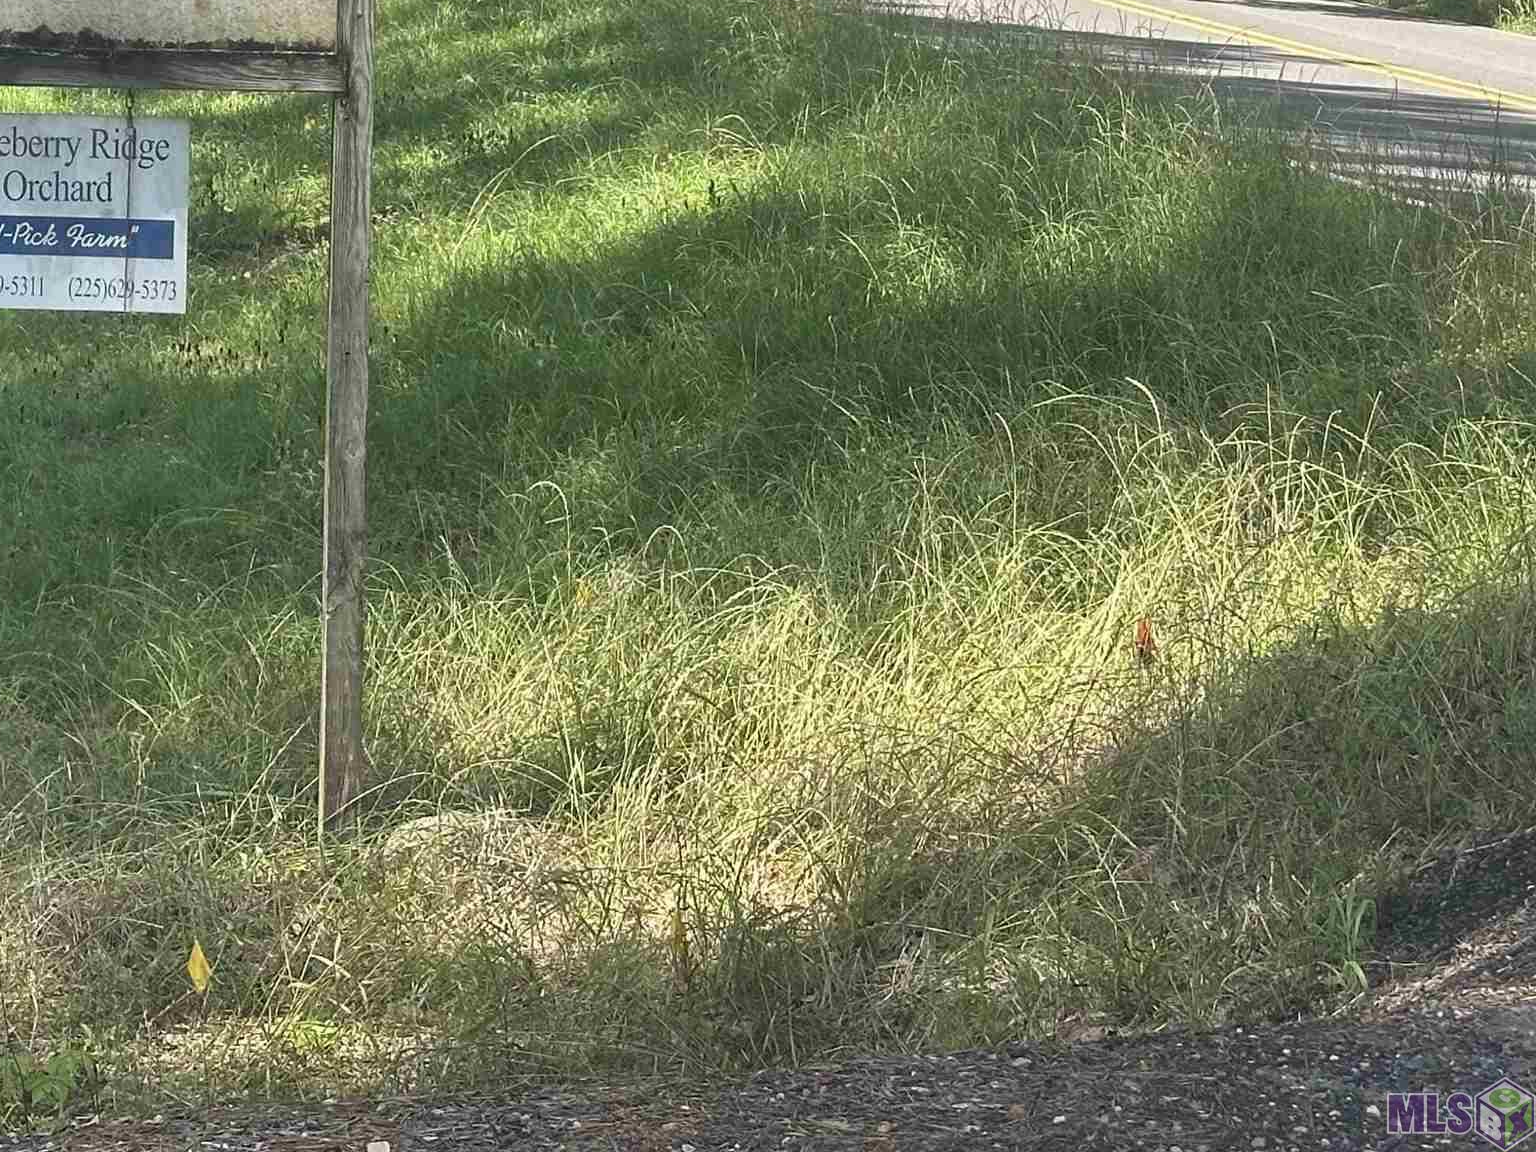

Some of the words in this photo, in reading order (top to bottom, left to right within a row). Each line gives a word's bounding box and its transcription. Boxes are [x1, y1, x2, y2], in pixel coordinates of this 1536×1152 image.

[90, 128, 170, 169] Ridge
[3, 170, 113, 202] Orchard
[67, 275, 178, 301] (225)629-5373
